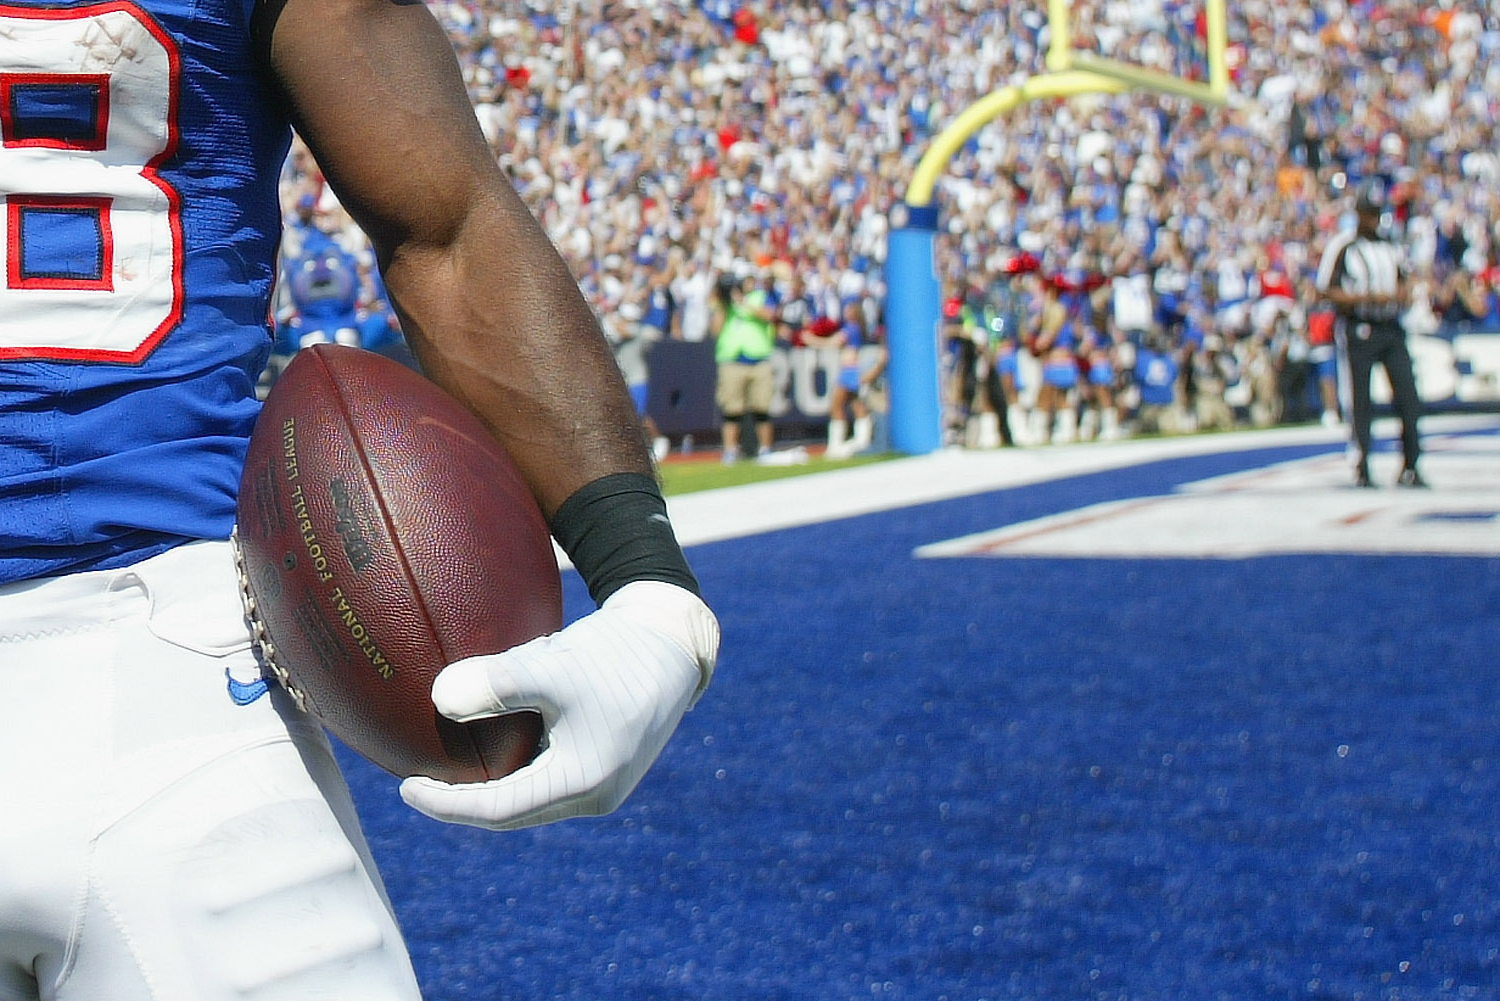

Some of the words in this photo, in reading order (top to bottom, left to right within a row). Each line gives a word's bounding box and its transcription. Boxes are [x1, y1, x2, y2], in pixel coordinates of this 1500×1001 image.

[283, 416, 300, 481] LEAGUE
[290, 484, 333, 583] FOOTBALL
[332, 586, 395, 681] NATIONAL
